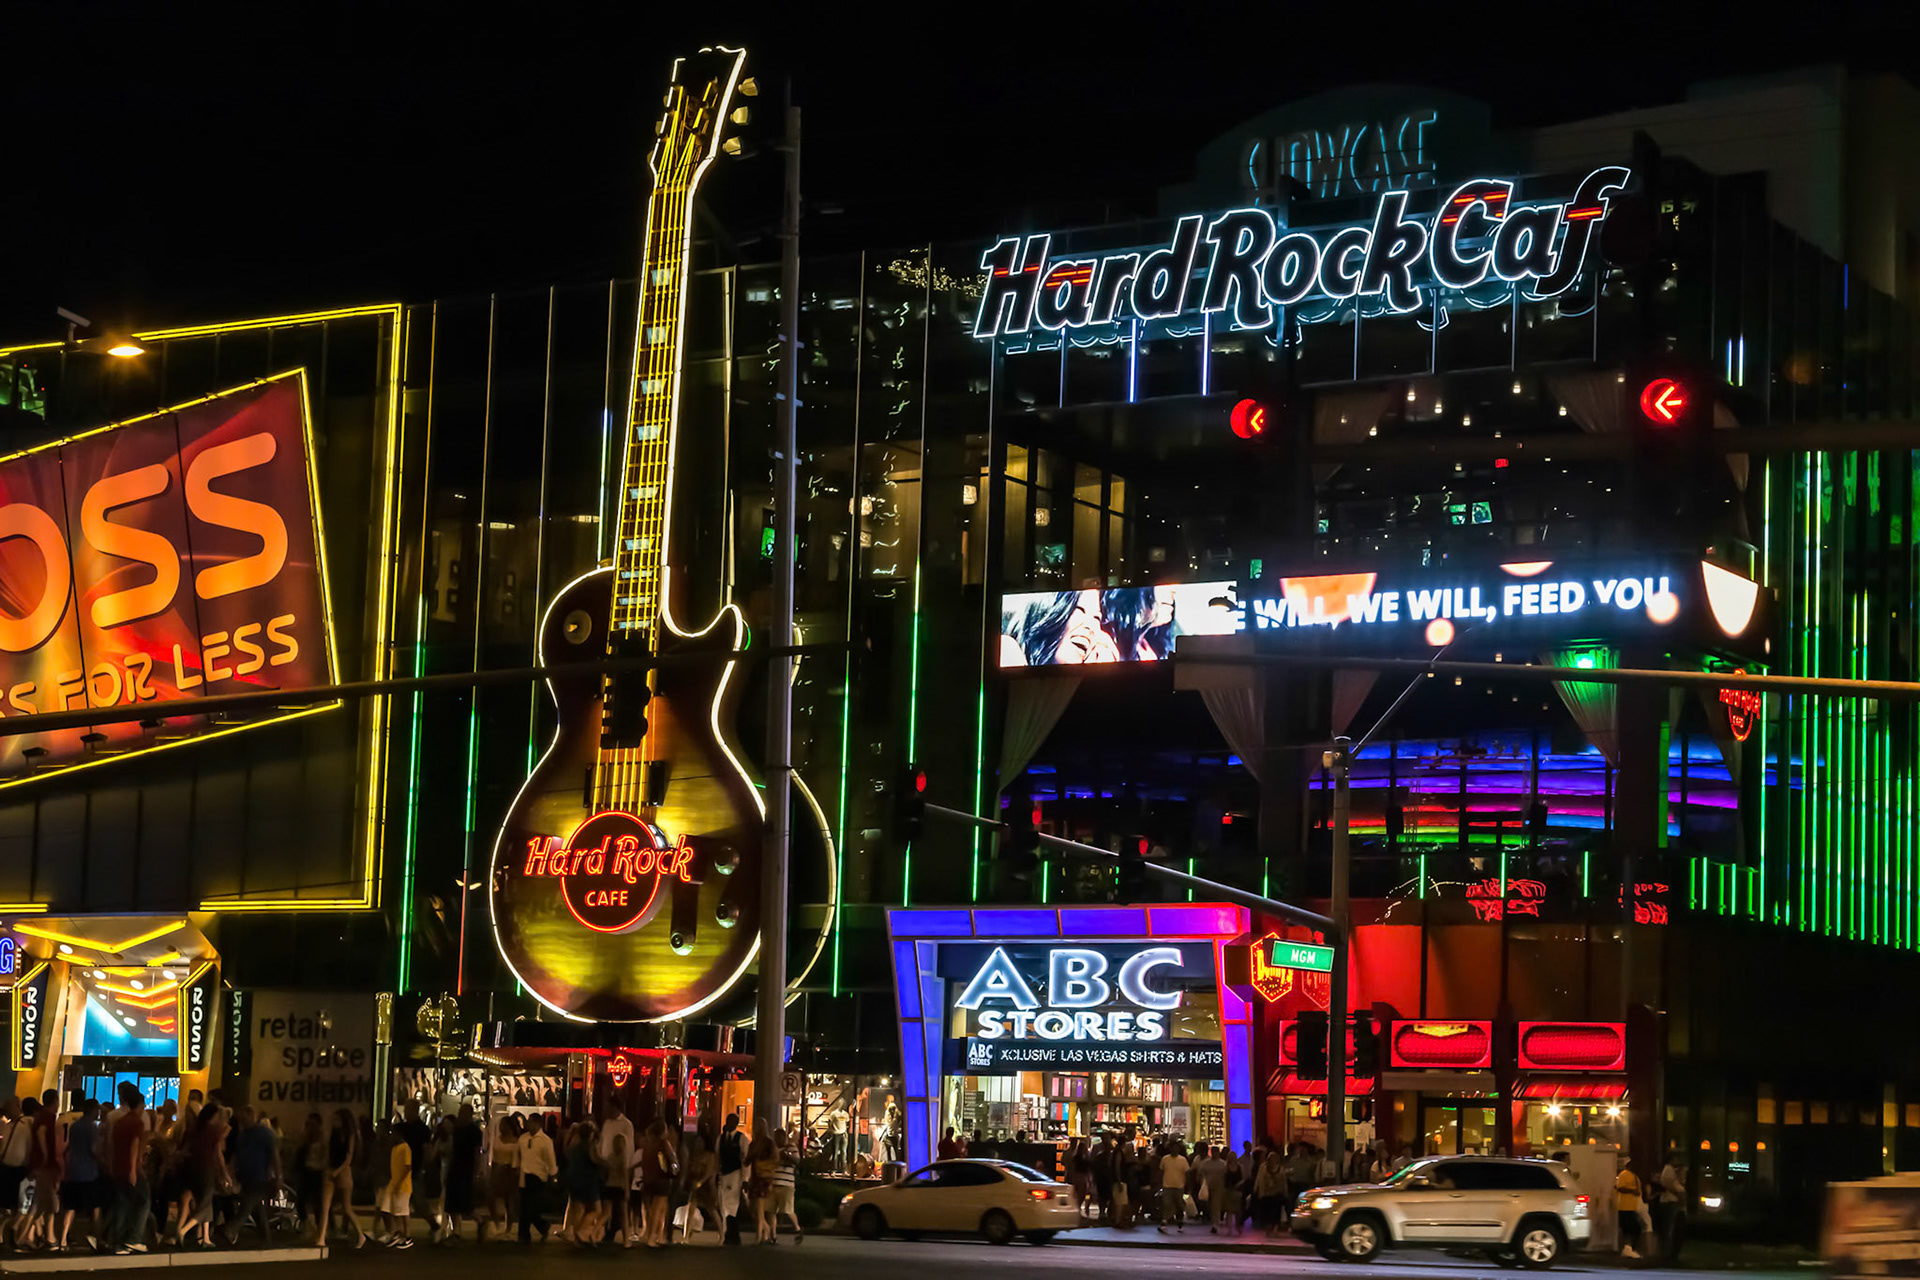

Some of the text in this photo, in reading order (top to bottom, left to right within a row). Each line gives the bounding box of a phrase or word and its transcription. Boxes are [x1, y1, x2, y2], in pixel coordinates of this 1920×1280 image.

[973, 214, 1203, 339] Hard
[1200, 189, 1433, 329] Rock
[1347, 592, 1399, 623] WE
[1407, 586, 1497, 623] WILL,
[1504, 581, 1585, 616] FEED
[1593, 576, 1671, 612] YOU
[57, 652, 156, 712] FOR
[172, 613, 299, 690] LESS
[523, 833, 694, 884] Hard Rock
[584, 890, 629, 907] CAFE
[1291, 948, 1316, 965] MGM
[955, 946, 1184, 1010] ABC
[23, 986, 38, 1060] ROSS
[191, 987, 204, 1063] ROSS
[977, 1010, 1164, 1041] STORES
[282, 1045, 366, 1074] space
[969, 1043, 993, 1059] ABC
[970, 1058, 990, 1066] STORES
[1060, 1049, 1084, 1062] LAS
[1085, 1050, 1128, 1062] VEGAS
[1130, 1050, 1175, 1063] SHIRTS
[1177, 1052, 1185, 1063] &
[1188, 1052, 1222, 1064] HATS
